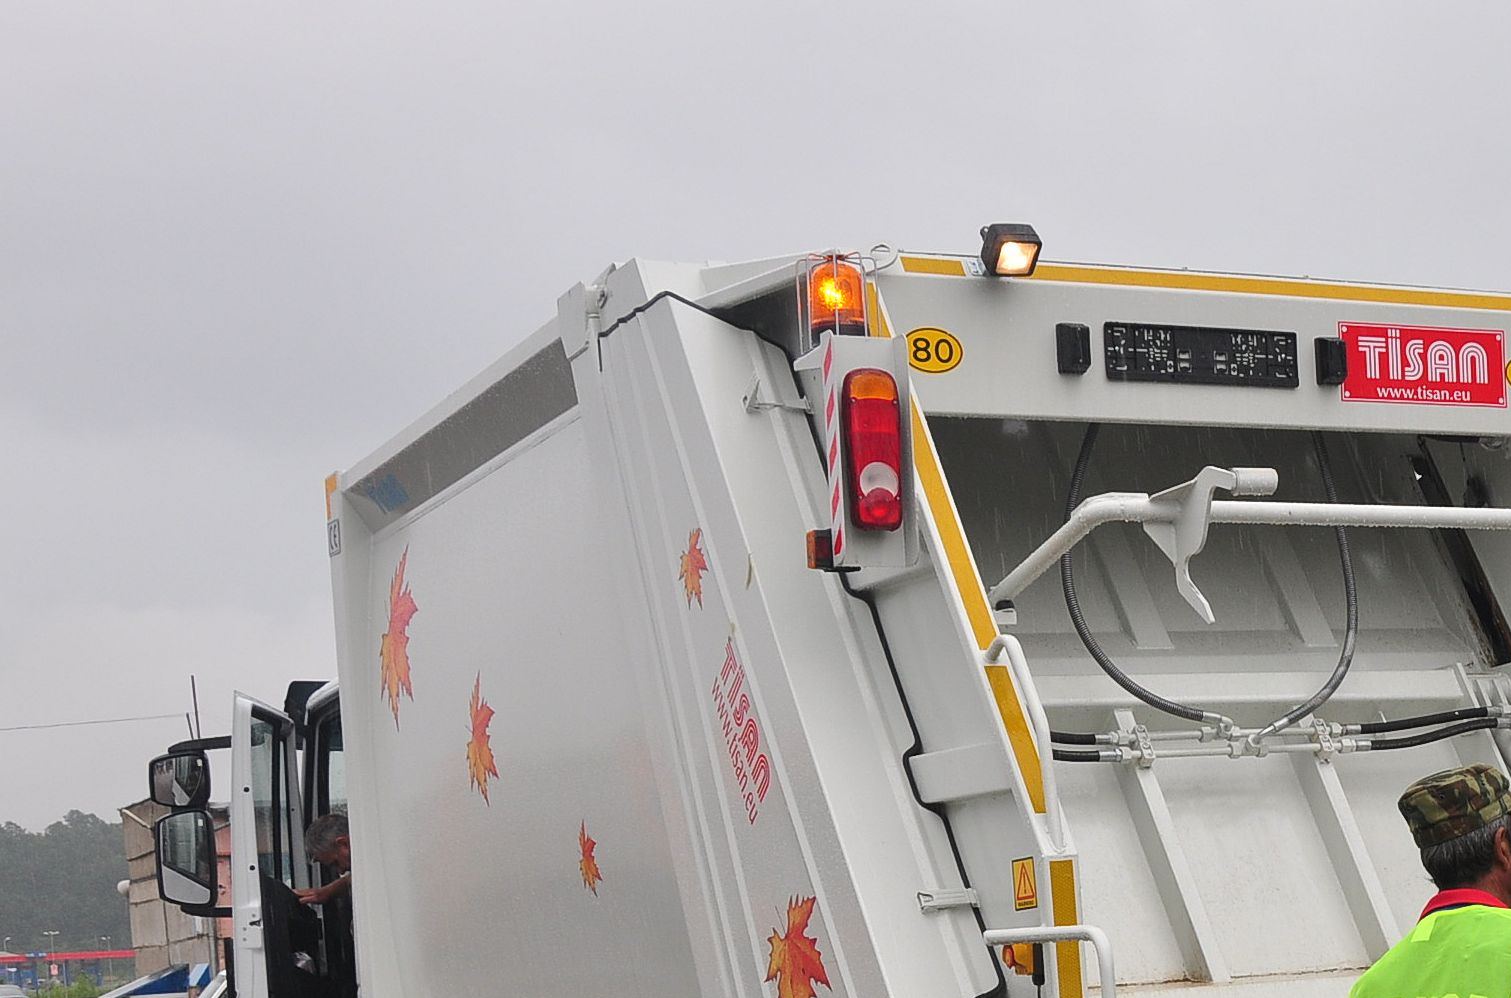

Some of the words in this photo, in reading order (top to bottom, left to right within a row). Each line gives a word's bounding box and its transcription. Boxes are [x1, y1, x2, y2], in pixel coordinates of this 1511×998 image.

[912, 337, 954, 364] 80
[1376, 385, 1471, 402] www.tisan.eu
[711, 676, 759, 825] www.tisan.eu
